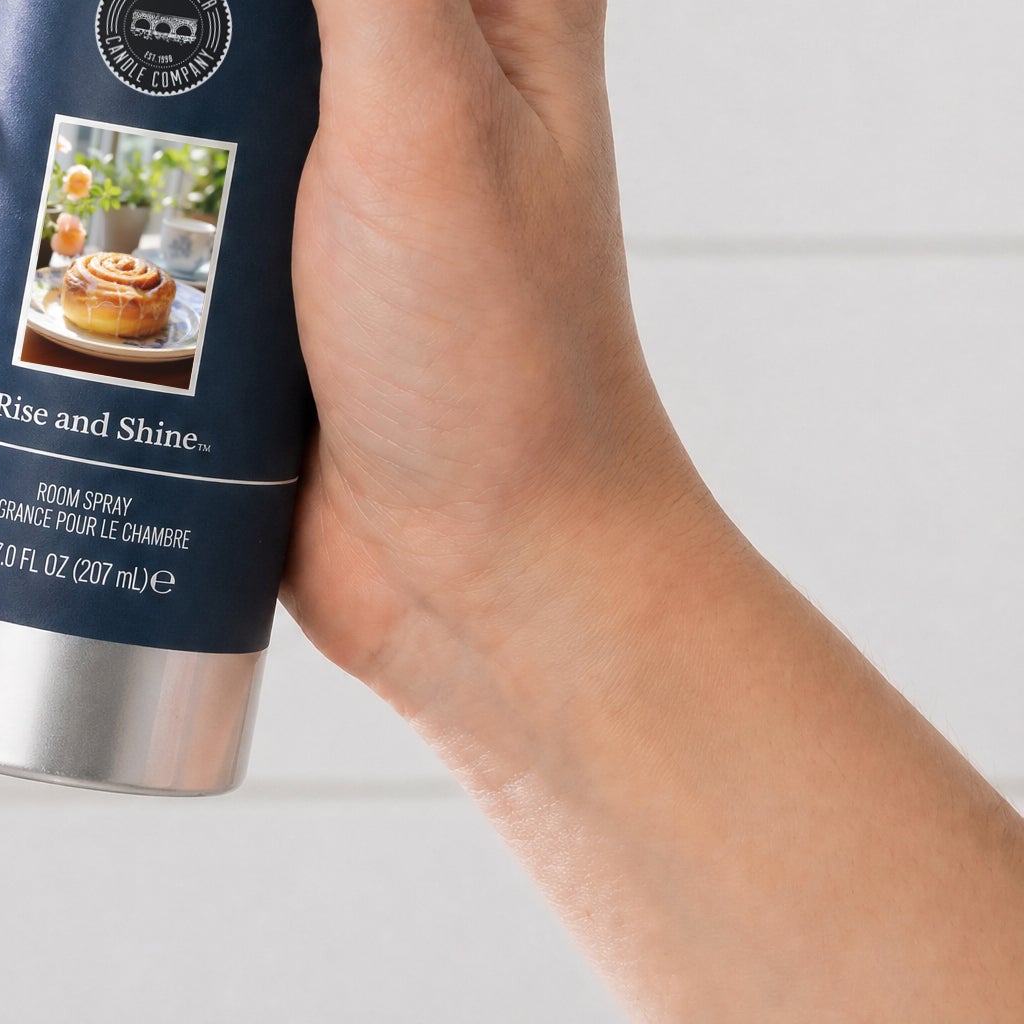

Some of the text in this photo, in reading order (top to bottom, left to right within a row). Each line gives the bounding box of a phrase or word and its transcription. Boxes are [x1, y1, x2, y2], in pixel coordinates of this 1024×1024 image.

[105, 35, 214, 88] CANDLE COMPANY
[54, 412, 110, 438] and
[37, 482, 133, 517] ROOM SPRAY
[56, 511, 97, 537] POUR
[100, 519, 120, 540] LE
[122, 522, 192, 550] CHAMBRE
[19, 547, 38, 574] FL
[44, 553, 70, 579] OZ
[72, 557, 114, 586] (207
